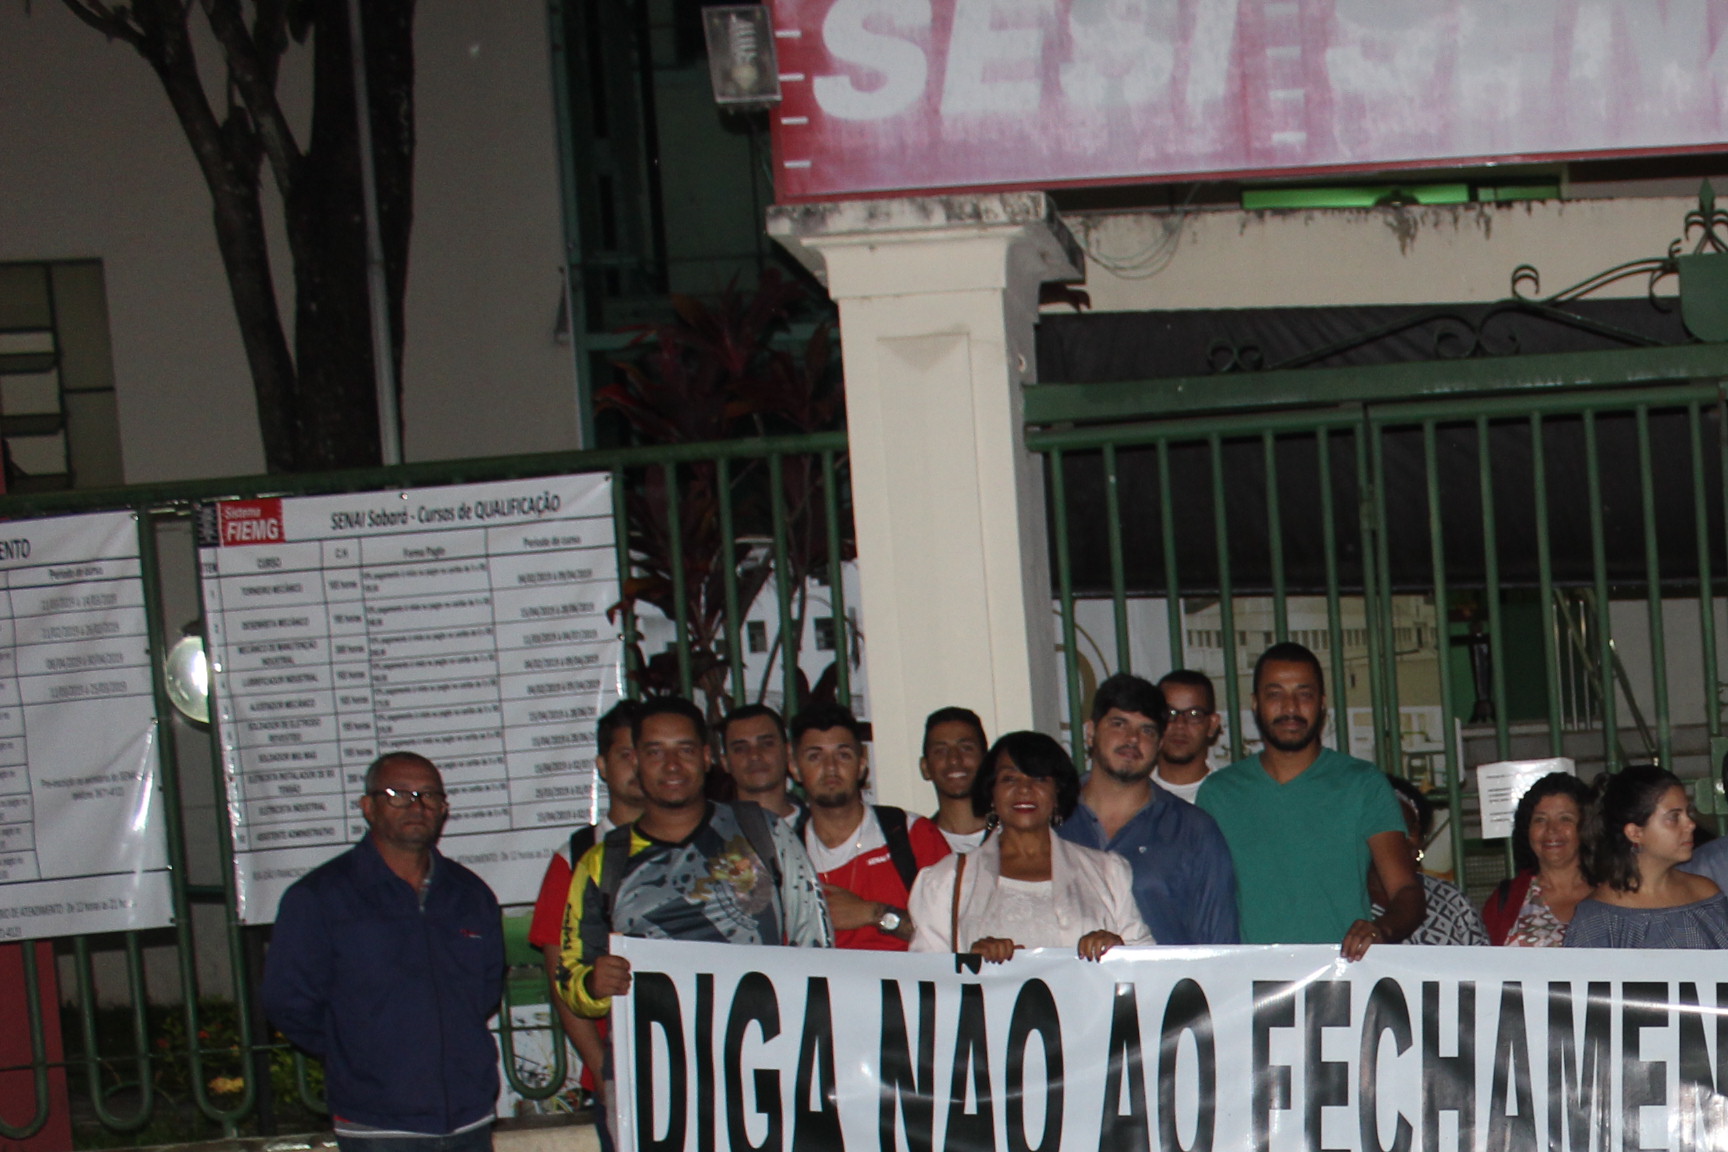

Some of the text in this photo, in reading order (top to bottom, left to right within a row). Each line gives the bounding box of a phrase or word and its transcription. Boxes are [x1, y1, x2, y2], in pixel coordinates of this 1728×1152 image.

[331, 511, 366, 530] SENAI
[418, 505, 454, 524] Cursos
[458, 502, 472, 520] de
[474, 491, 561, 521] QUALIFICAÇÃO
[227, 519, 280, 542] FIEMG
